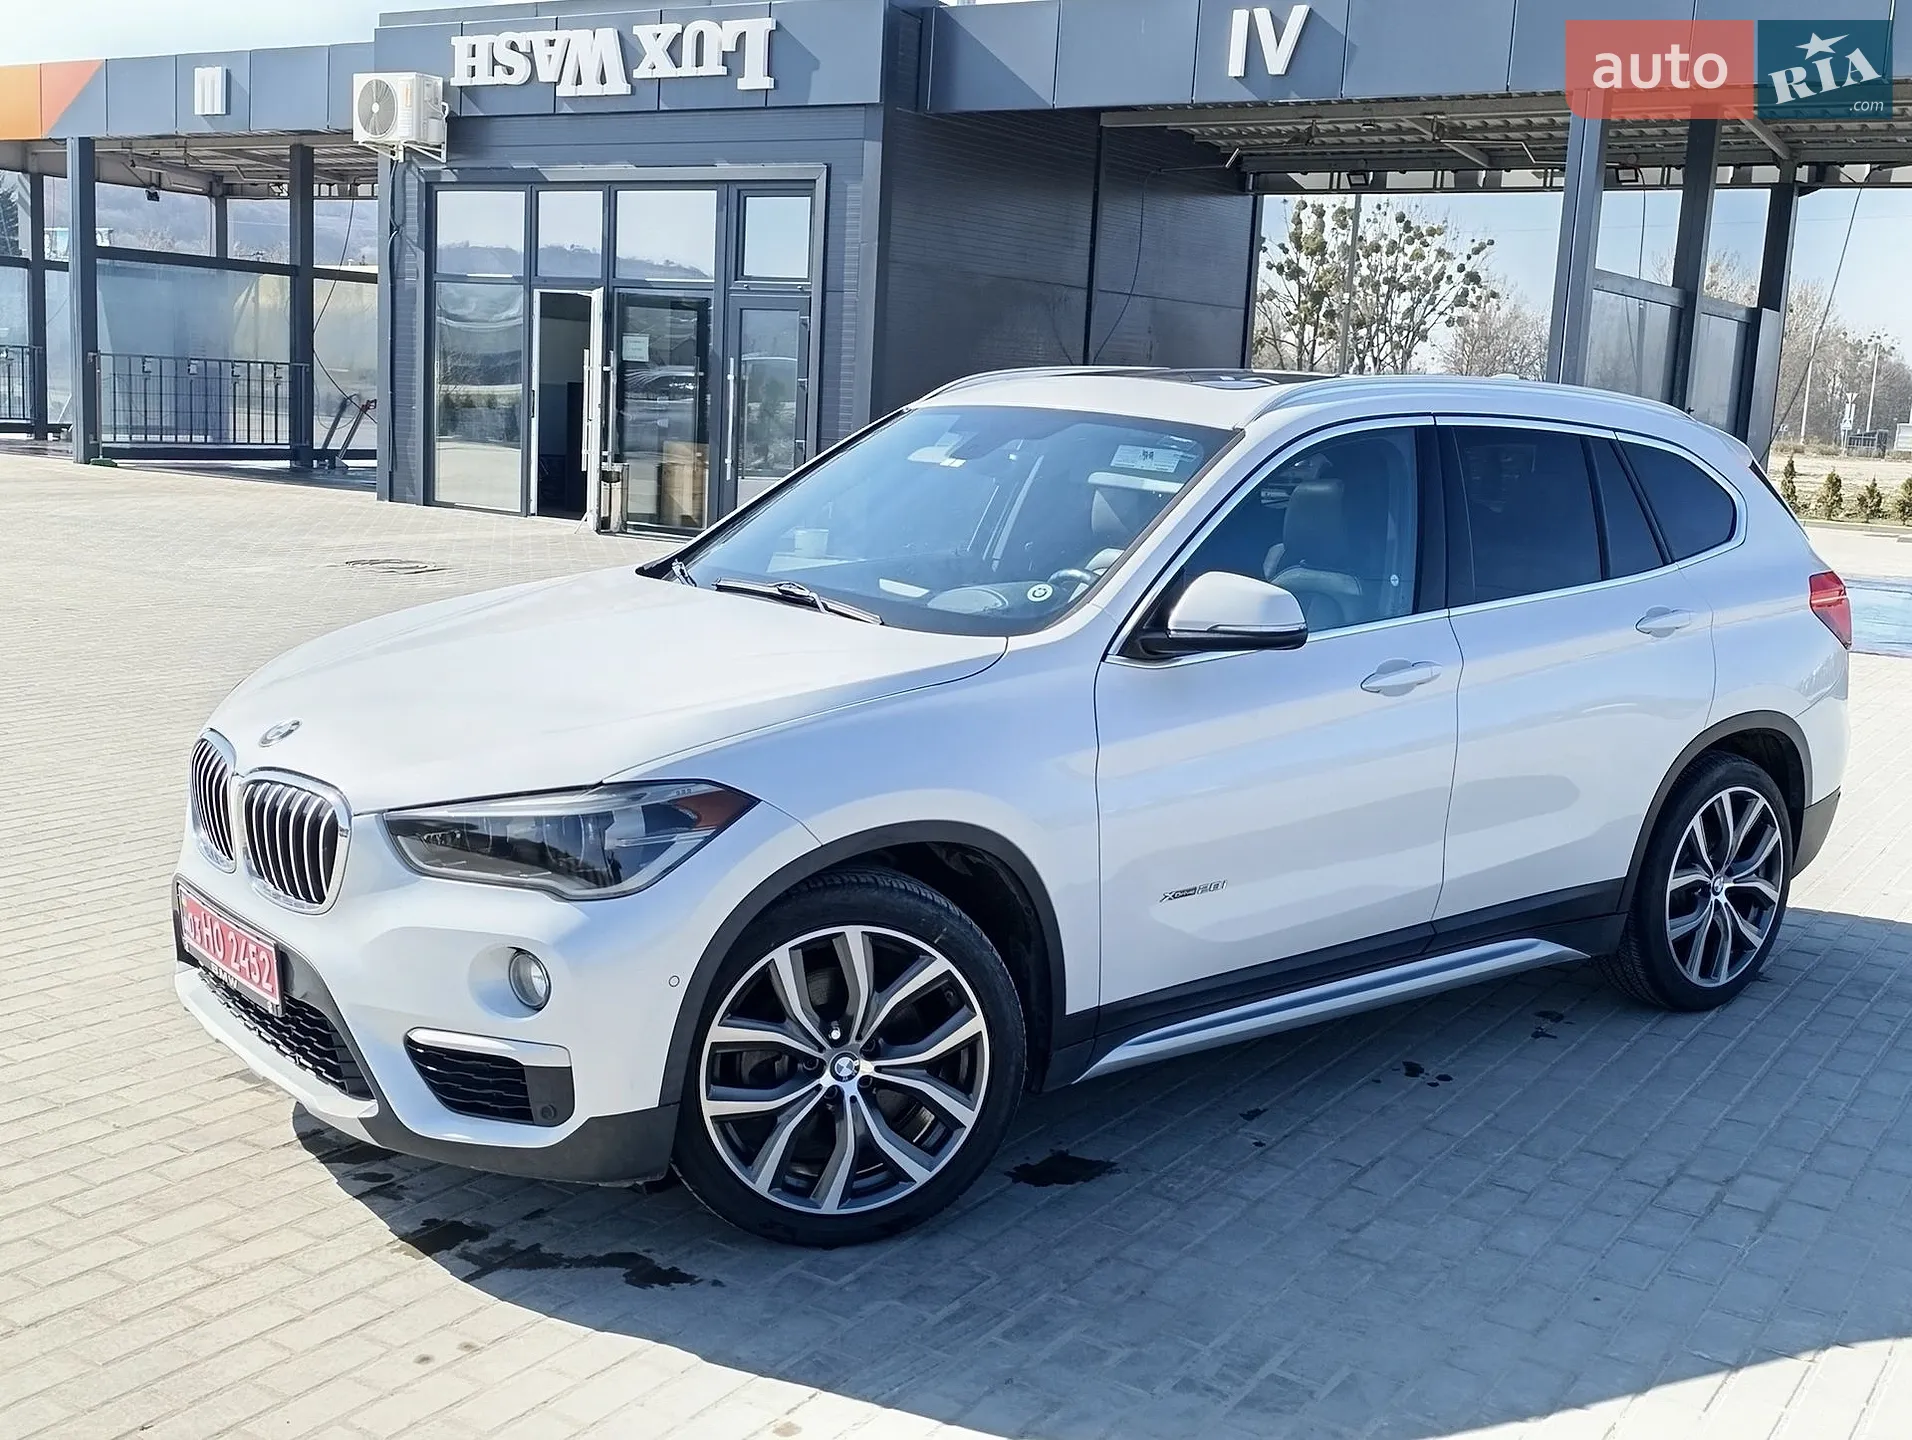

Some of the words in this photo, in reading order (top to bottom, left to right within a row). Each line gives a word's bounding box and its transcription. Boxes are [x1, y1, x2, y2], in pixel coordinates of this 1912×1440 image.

[450, 28, 631, 97] WASH
[632, 17, 776, 90] LUX
[1228, 5, 1309, 77] IV
[228, 931, 273, 993] 2452
